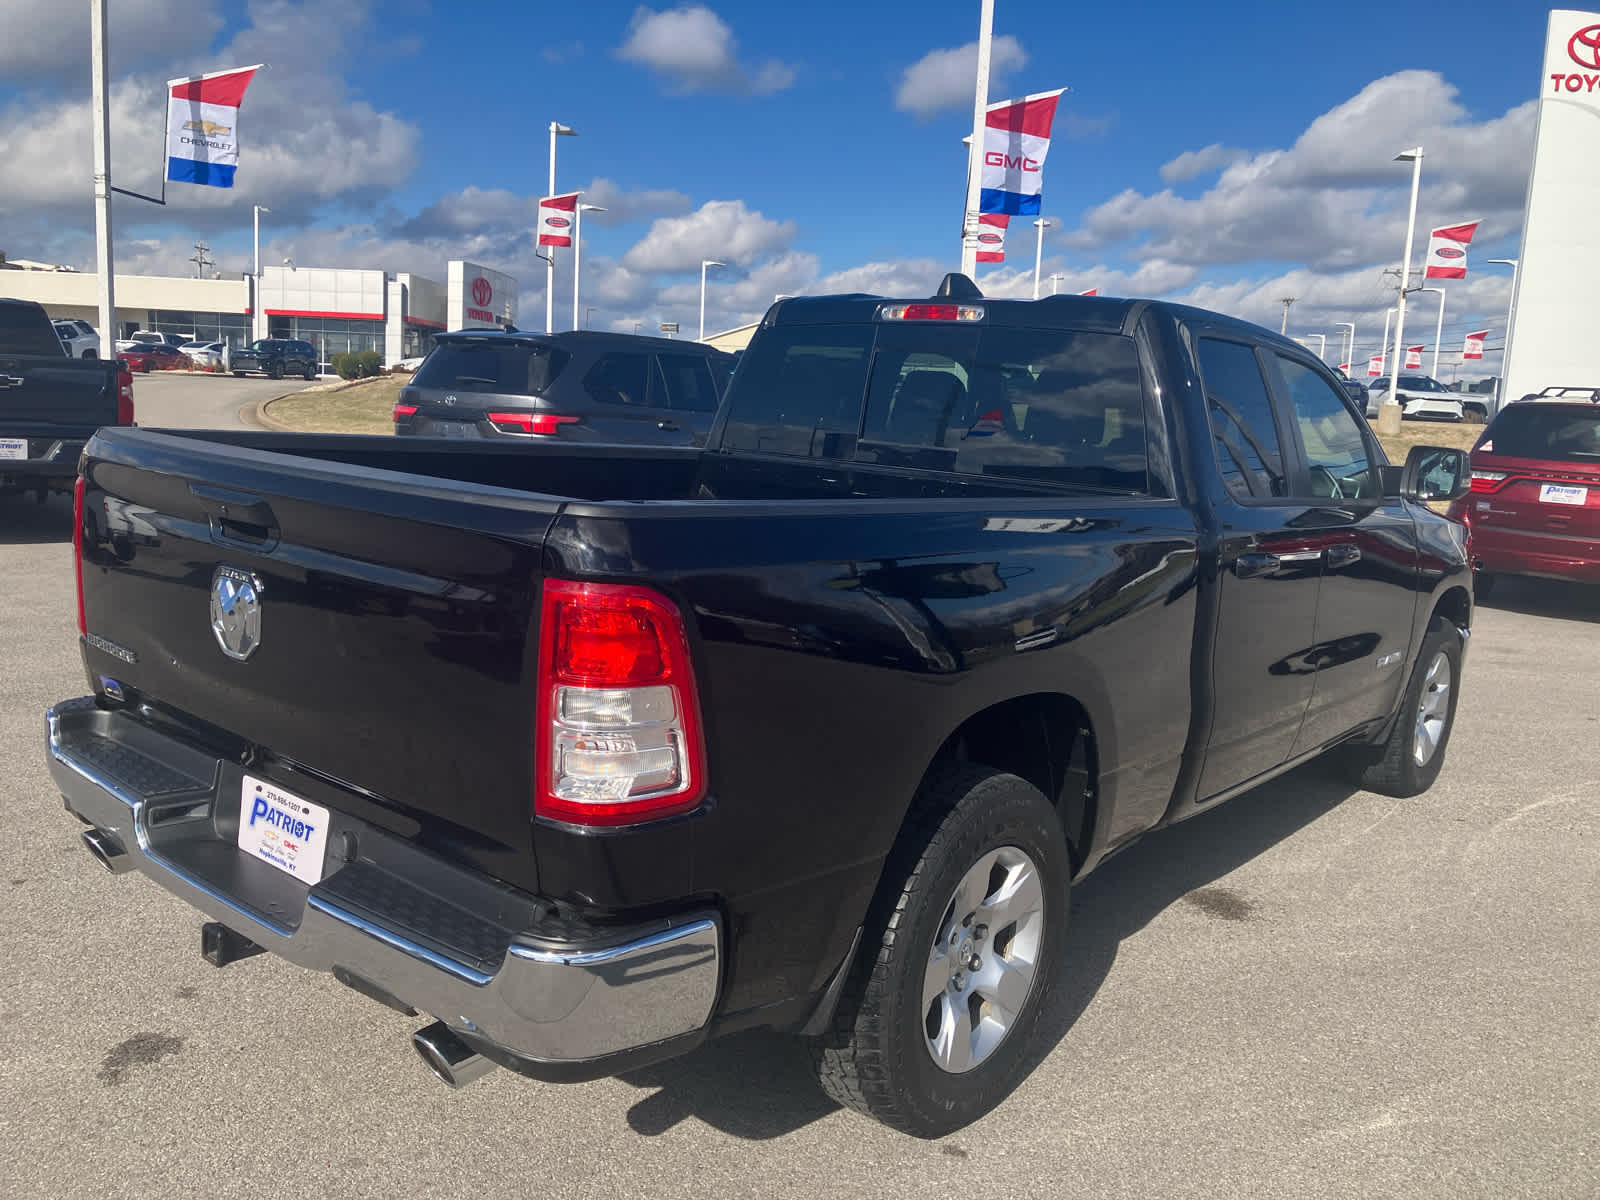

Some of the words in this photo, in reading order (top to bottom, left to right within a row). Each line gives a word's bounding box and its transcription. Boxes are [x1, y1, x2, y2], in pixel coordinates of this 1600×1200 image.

[1551, 73, 1600, 92] TOY
[180, 136, 232, 150] CHEVROLET
[985, 151, 1039, 172] GMC
[466, 306, 494, 323] TOYOTA
[1546, 486, 1582, 495] PATRIOT
[249, 797, 315, 842] PATRIOT
[283, 839, 299, 853] GMC
[288, 862, 297, 872] KY
